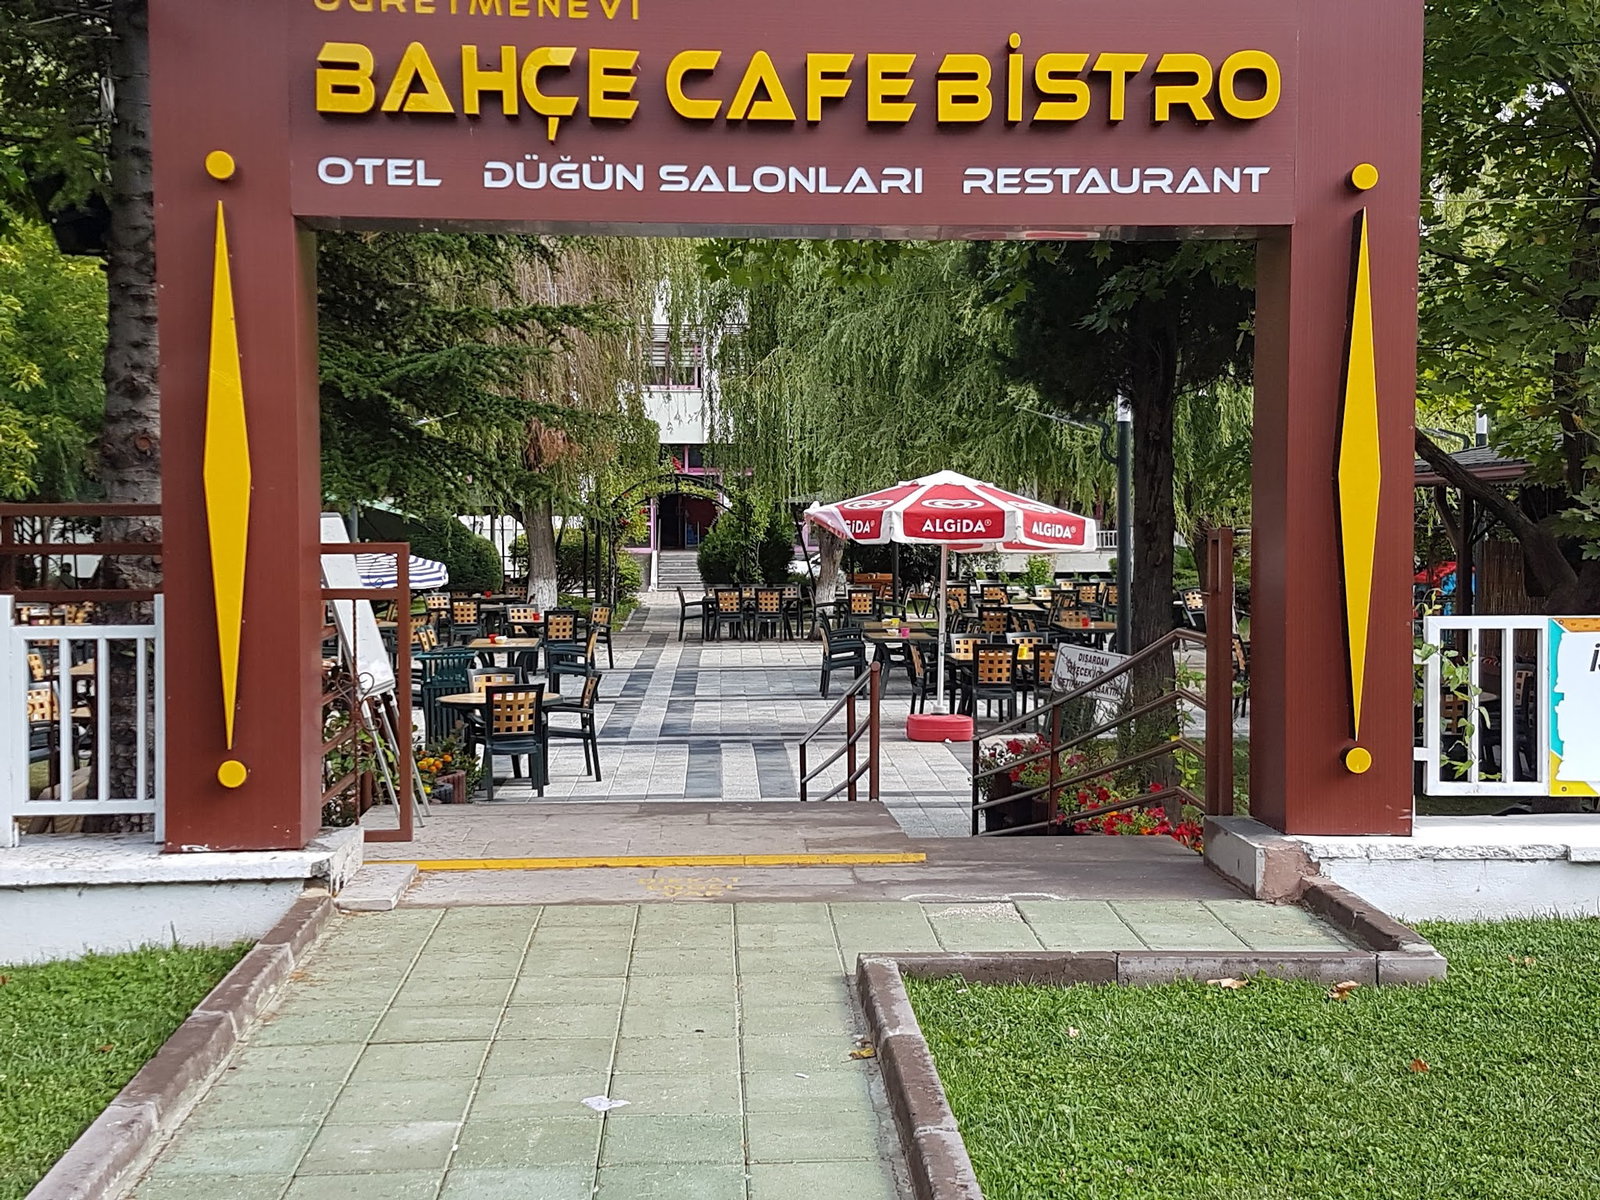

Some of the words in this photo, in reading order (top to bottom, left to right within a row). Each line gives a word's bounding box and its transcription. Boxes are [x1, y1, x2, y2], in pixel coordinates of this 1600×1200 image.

[315, 40, 640, 142] BAHÇE
[665, 49, 918, 123] CAFE
[937, 32, 1282, 123] BİSTRO
[316, 156, 443, 188] OTEL
[482, 153, 645, 192] DÜĞÜN
[658, 164, 924, 195] SALONLARI
[962, 166, 1272, 195] RESTAURANT
